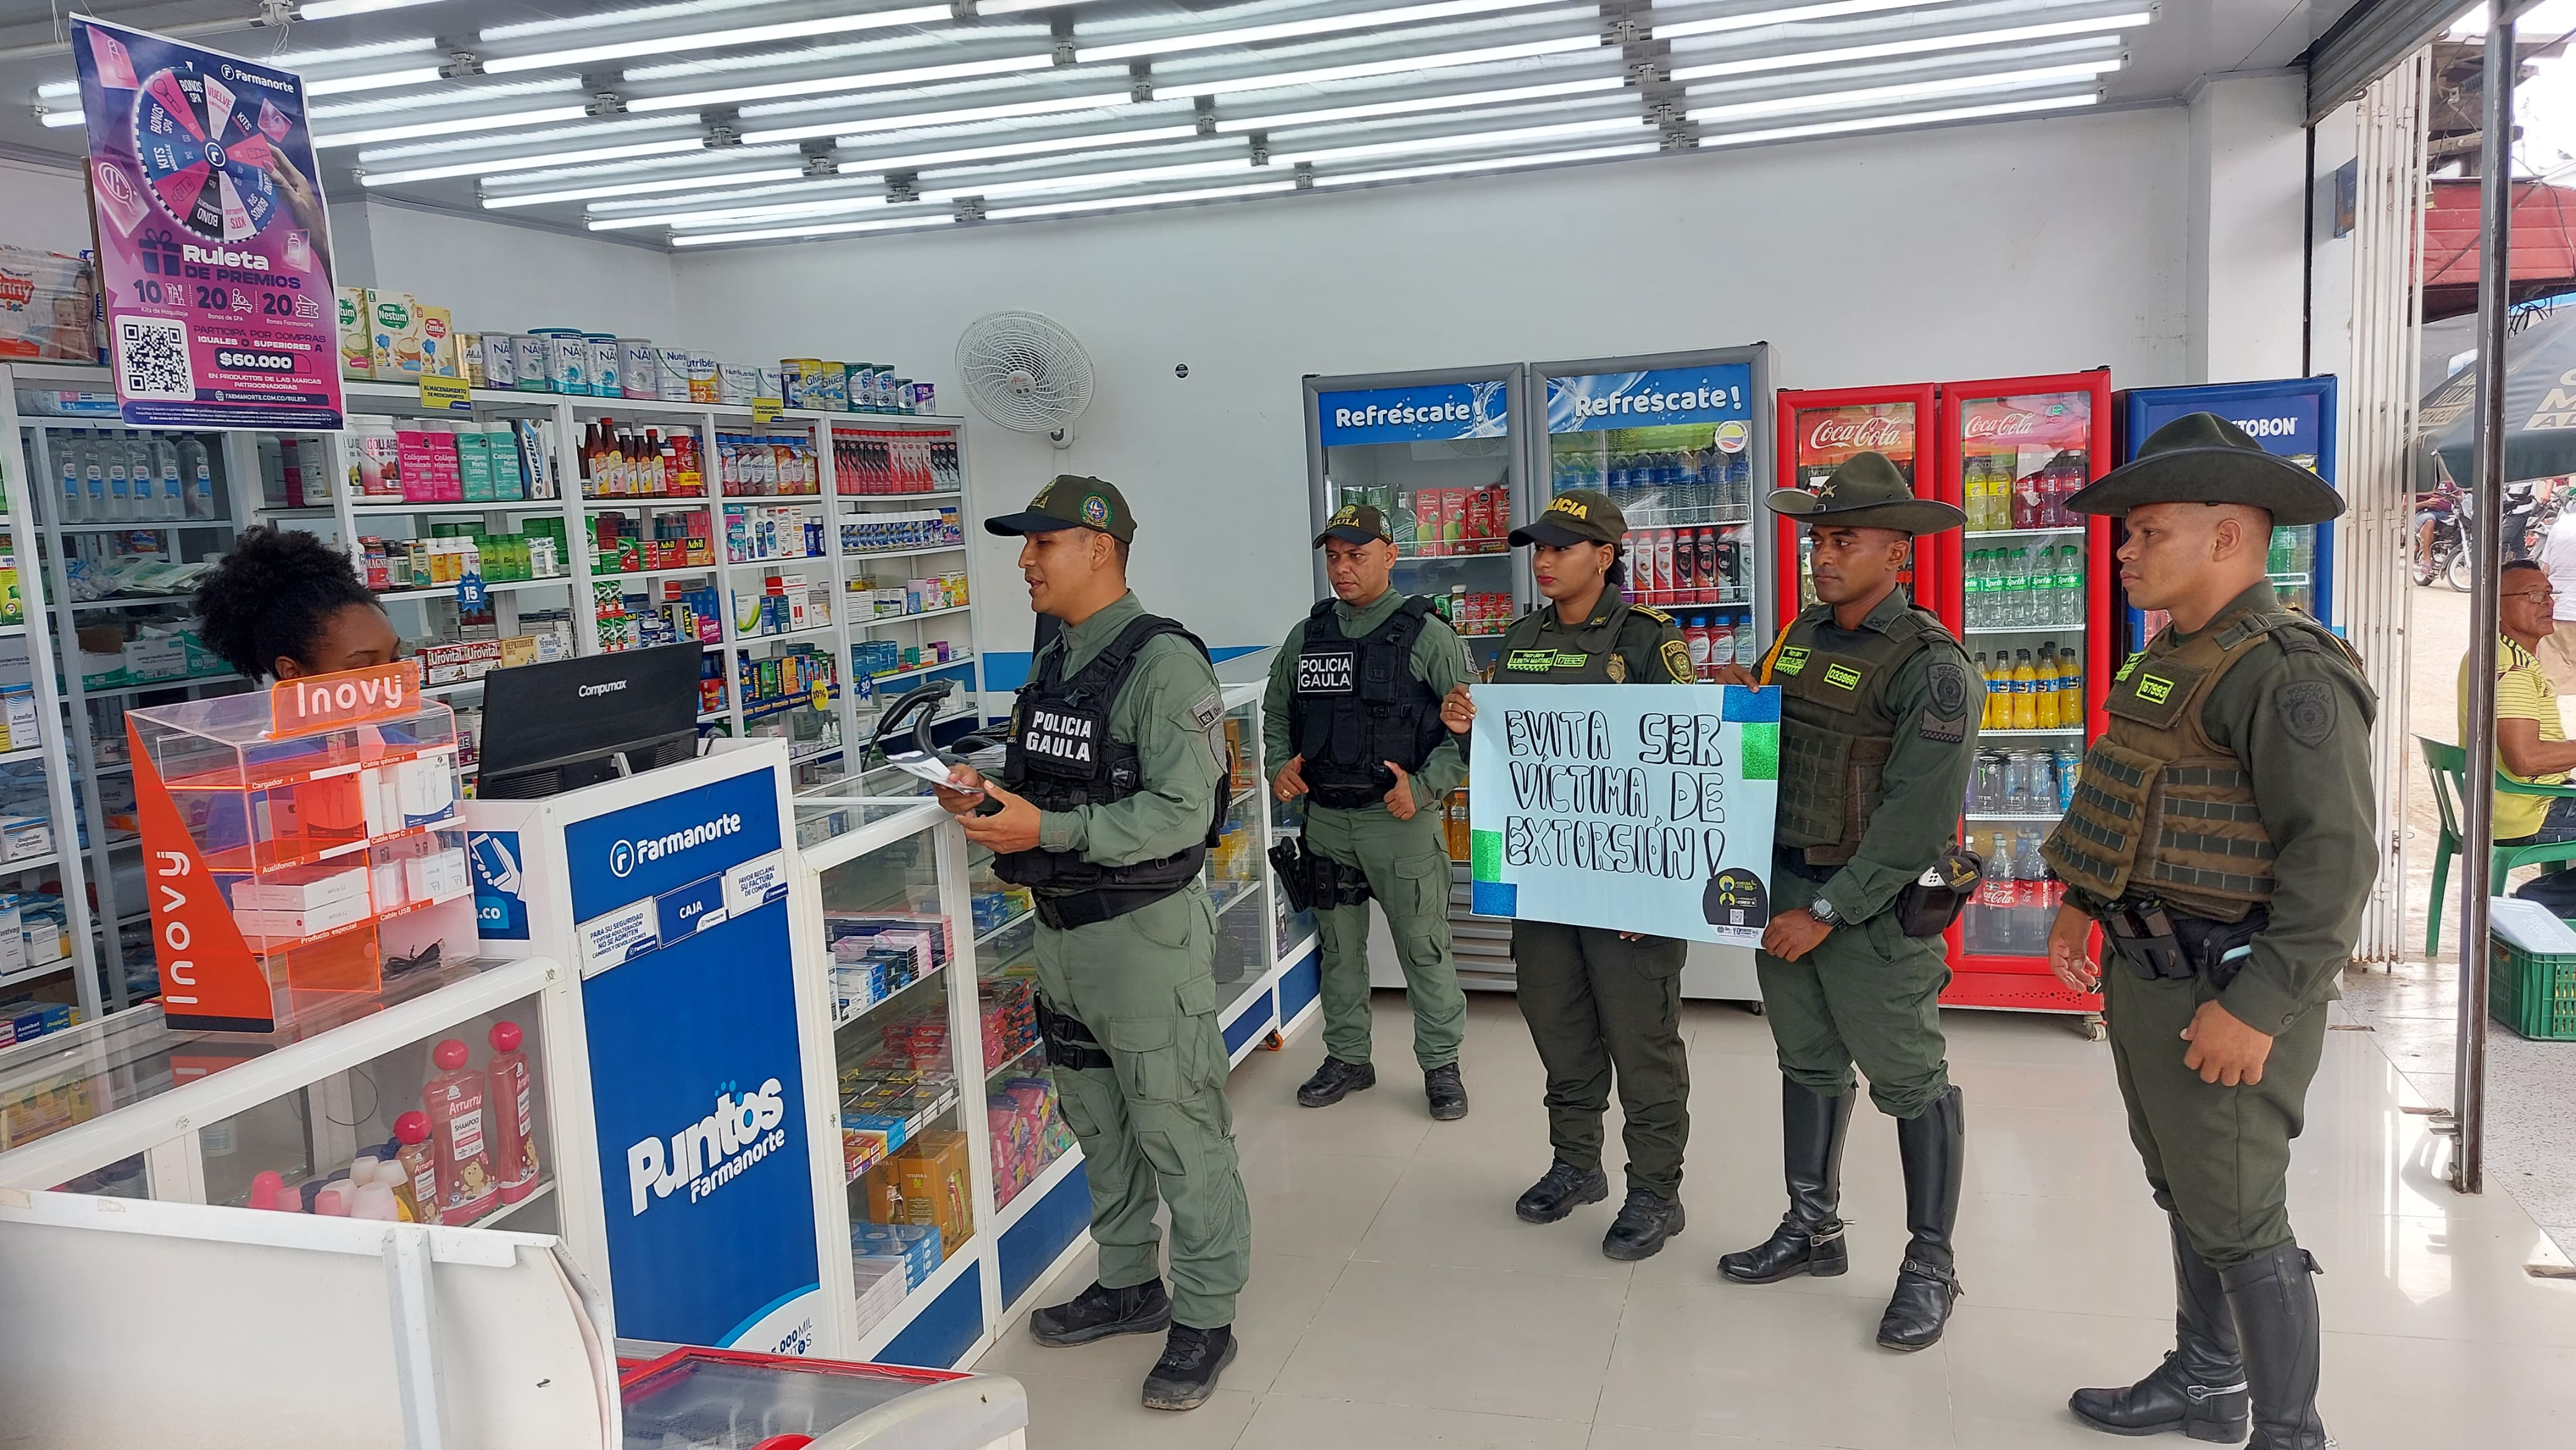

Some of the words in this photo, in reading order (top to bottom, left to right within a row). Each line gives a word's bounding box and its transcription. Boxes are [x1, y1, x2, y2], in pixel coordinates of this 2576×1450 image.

[180, 79, 203, 93] BONOS
[235, 69, 294, 93] Farmanorte
[191, 93, 202, 103] SPA
[207, 85, 232, 109] VUELVE
[150, 103, 164, 134] BONOS
[163, 118, 173, 134] SPA
[237, 112, 252, 131] KITS
[154, 147, 170, 170] KITS
[197, 207, 219, 227] BONO
[230, 217, 246, 229] KITS
[183, 244, 270, 271] Ruleta
[185, 265, 211, 280] DE
[217, 268, 302, 290] PREMIOS
[133, 279, 162, 304] 10
[196, 285, 227, 310] 20
[263, 293, 292, 316] 20
[284, 319, 314, 328] Farmanorte
[378, 310, 407, 322] Nestum
[194, 326, 246, 336] PARTICIPA
[250, 329, 272, 339] POR
[275, 332, 326, 343] COMPRAS
[426, 324, 445, 334] Cerelac
[198, 336, 238, 345] IGUALES
[242, 339, 250, 347] O
[254, 340, 311, 350] SUPERIORES
[494, 344, 510, 354] NA
[523, 345, 541, 355] NA
[564, 346, 582, 357] NA
[600, 350, 617, 362] NA
[630, 347, 651, 360] NA
[667, 352, 686, 361] Nutri
[219, 352, 292, 369] $60.000
[687, 358, 714, 367] utribén
[220, 374, 263, 382] PRODUCTOS
[234, 382, 297, 390] PATROCINADORAS
[424, 385, 466, 394] ALMACENAMIENTO
[700, 386, 707, 401] 3
[1810, 416, 1905, 449] Coca-Cola
[1965, 412, 2036, 438] Coca-Cola
[2233, 417, 2297, 436] TOBON
[367, 438, 398, 450] COLLAGE
[404, 453, 430, 463] Colágeno
[434, 454, 457, 463] Colágen
[493, 453, 517, 461] Colágen
[1546, 498, 1588, 520] LICIA
[660, 540, 675, 549] Advil
[687, 540, 703, 549] Advil
[2006, 576, 2026, 586] Sprite
[2032, 575, 2053, 584] Sprite
[2058, 574, 2077, 583] Sprite
[464, 586, 478, 601] 15
[431, 650, 463, 665] Urovital
[468, 646, 498, 660] Urovital
[1300, 659, 1351, 673] POLICIA
[861, 681, 871, 692] 30
[1300, 673, 1351, 688] GAULA
[578, 680, 627, 698] Compumax
[812, 690, 827, 699] 10%
[12, 713, 33, 721] Amefar
[1032, 711, 1092, 738] POLICIA
[1201, 712, 1212, 724] RH
[1504, 710, 1611, 760] EVITA
[1638, 713, 1723, 767] SER
[1026, 731, 1090, 762] GAULA
[363, 759, 379, 769] Cable
[380, 755, 400, 767] iphone
[252, 778, 284, 790] Cargador
[1508, 753, 1649, 819] VÍCTIMA
[1670, 771, 1725, 823] DE
[15, 838, 43, 849] Compuesto
[372, 835, 387, 844] Cable
[388, 833, 401, 843] tipo
[637, 812, 741, 865] Farmanorte
[262, 859, 297, 874] Audífonos
[738, 873, 754, 885] FAVOR
[754, 865, 775, 879] RECLAME
[741, 881, 749, 892] SU
[749, 872, 774, 888] FACTURA
[745, 888, 751, 897] DE
[751, 882, 772, 895] COMPRA
[380, 912, 398, 922] Cable
[398, 906, 411, 916] USB
[679, 900, 703, 919] CAJA
[1, 926, 20, 937] ntivag
[590, 927, 604, 939] PARA
[605, 926, 613, 934] SU
[613, 913, 643, 931] SEGURIDAD
[596, 933, 611, 944] EVITAR
[611, 921, 643, 938] ADULTERACIÓN
[301, 931, 329, 945] Producto
[332, 923, 357, 936] especial
[598, 939, 607, 949] NO
[607, 937, 614, 945] SE
[614, 927, 638, 944] ADMITEN
[592, 949, 611, 959] CAMBIOS
[615, 932, 647, 950] DEVOLUCIONES
[455, 1116, 479, 1132] SHAMPOO
[627, 1077, 784, 1217] Puntos
[690, 1128, 786, 1204] Farmanorte
[798, 1317, 812, 1337] MIL
